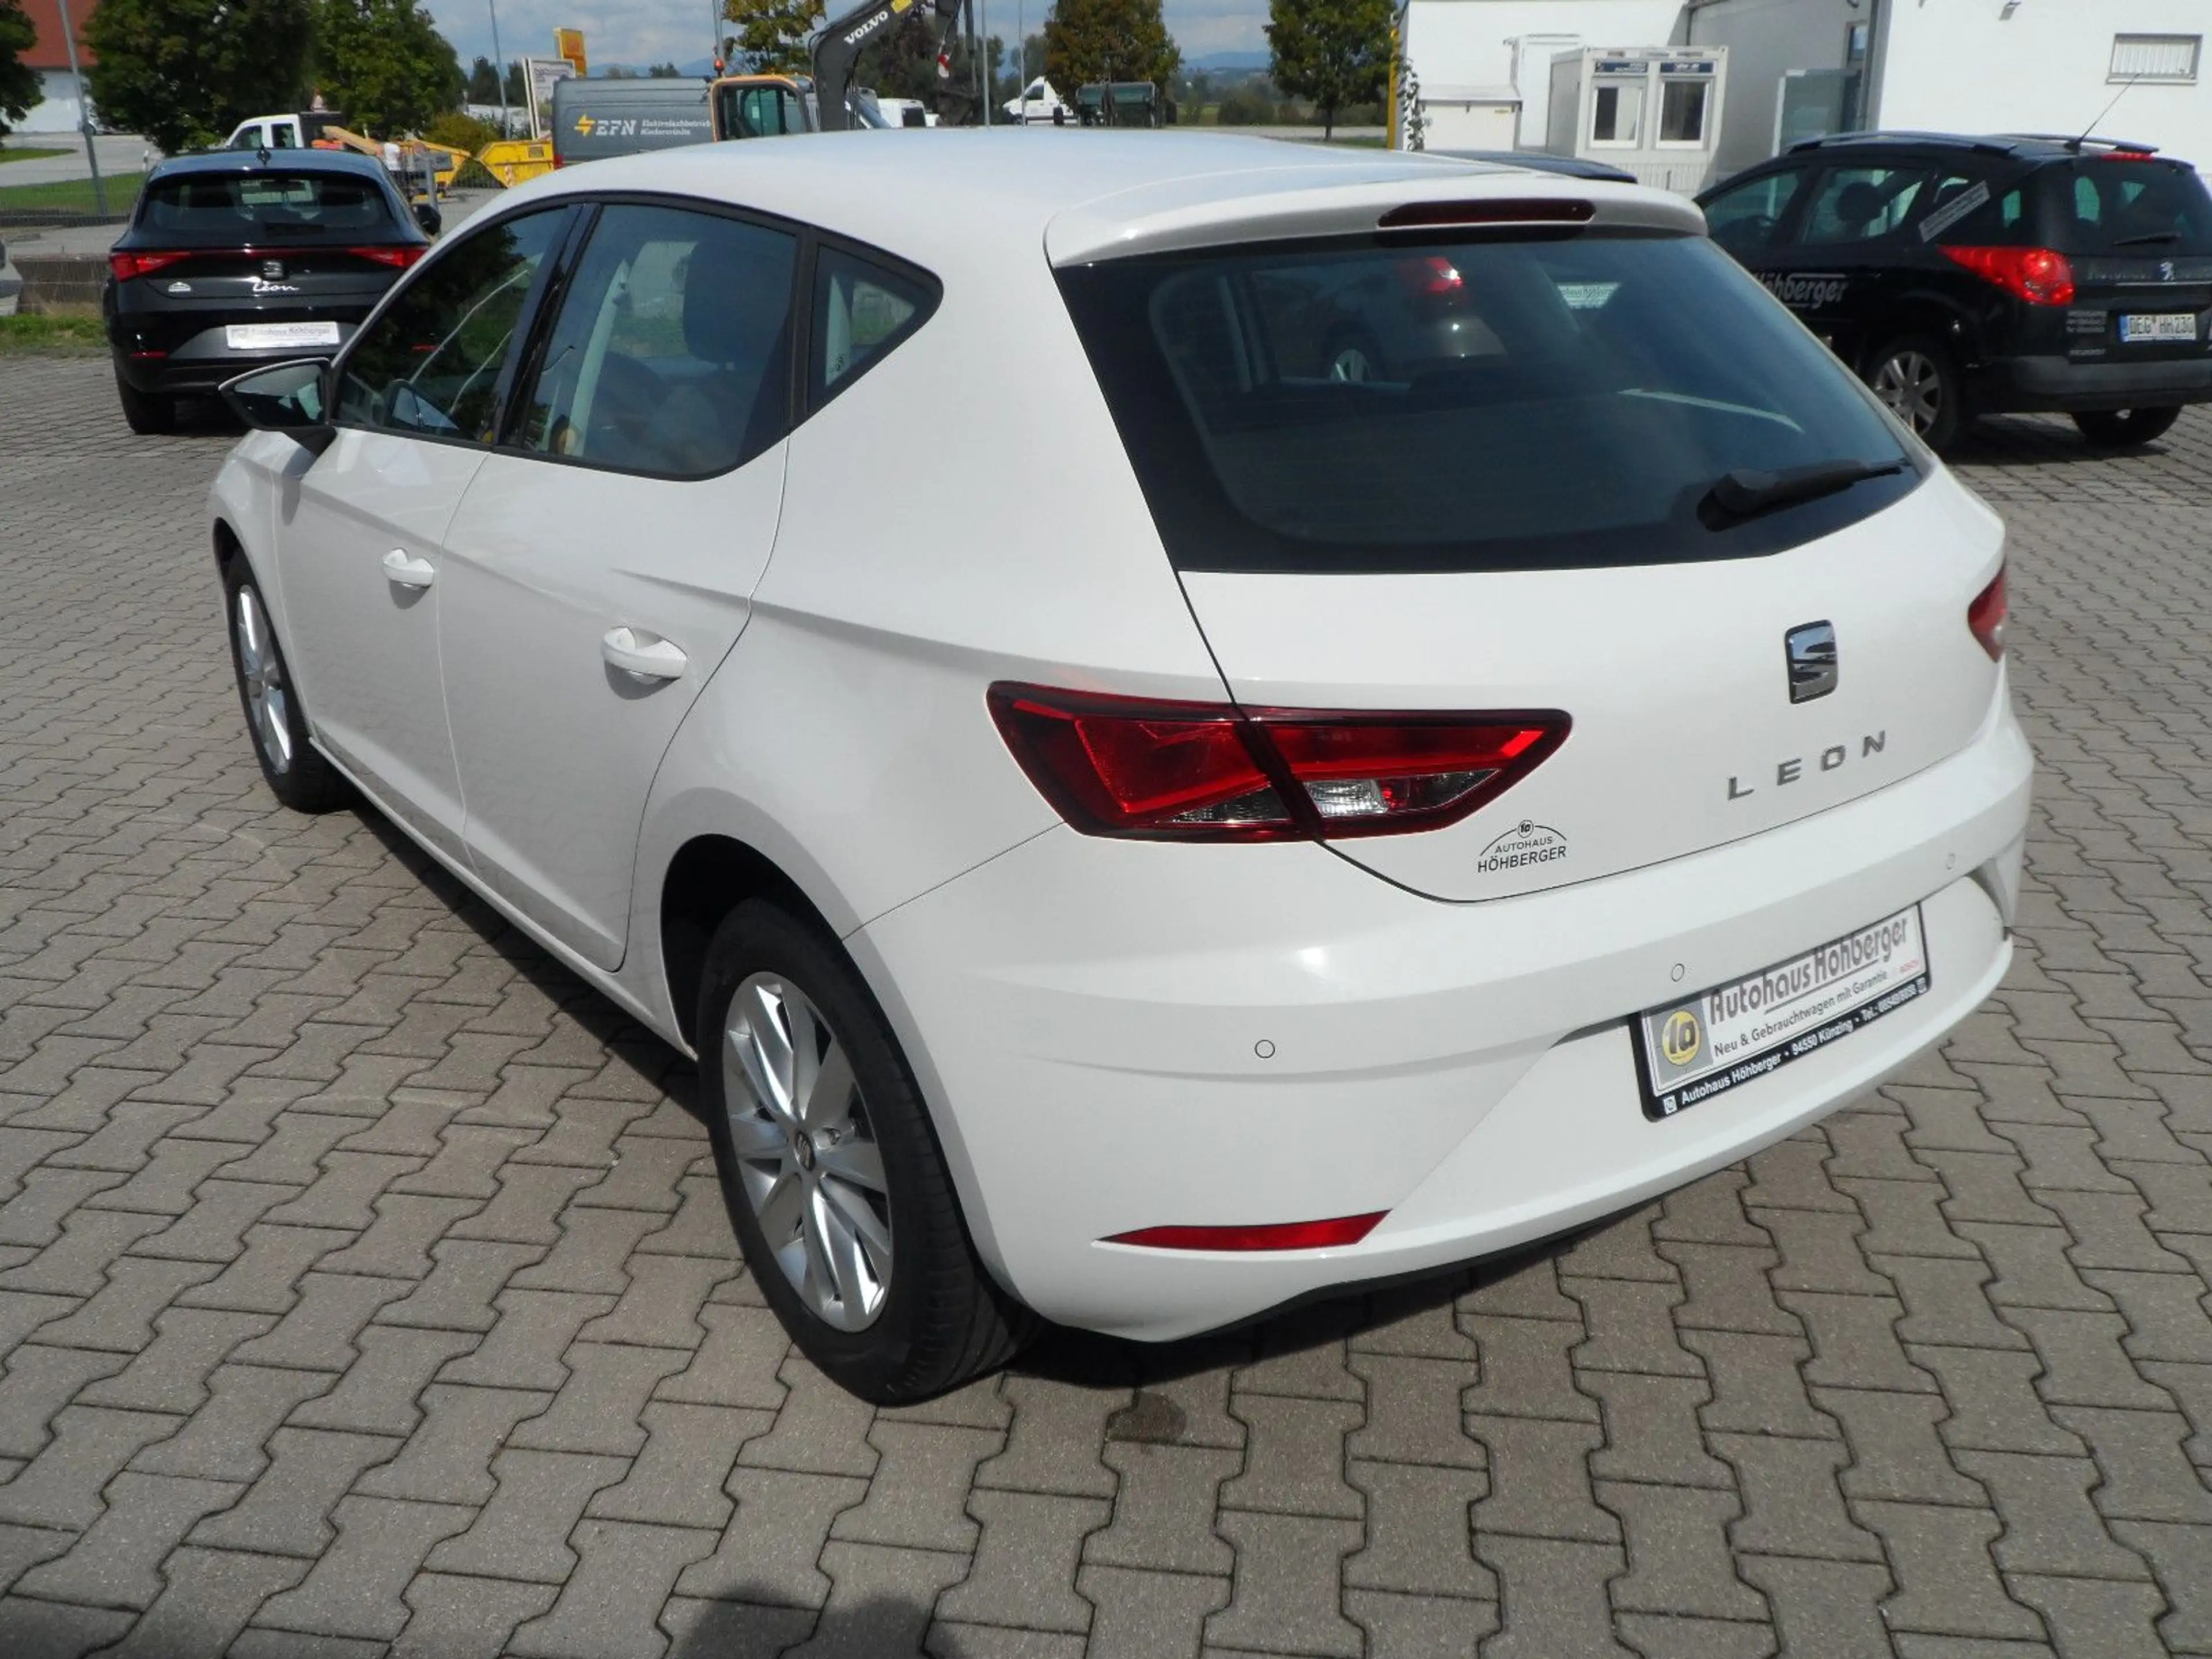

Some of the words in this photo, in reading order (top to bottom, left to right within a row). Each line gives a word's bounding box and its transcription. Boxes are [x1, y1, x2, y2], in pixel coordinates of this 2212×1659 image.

[843, 10, 888, 44] VOLVO
[596, 120, 637, 136] EFN
[1728, 730, 1886, 801] LEON
[1478, 846, 1566, 873] HÖHBERGER
[1494, 836, 1553, 854] AUTOHAUS
[1709, 963, 1810, 1025] Autohaus
[1714, 1041, 1738, 1057] Neu
[1740, 1033, 1749, 1047] &
[1751, 997, 1835, 1041] Gebrauchtwagen
[1853, 971, 1887, 994] Garantie
[1681, 1075, 1731, 1105] Autohaus
[1732, 1052, 1782, 1084] Höhberger
